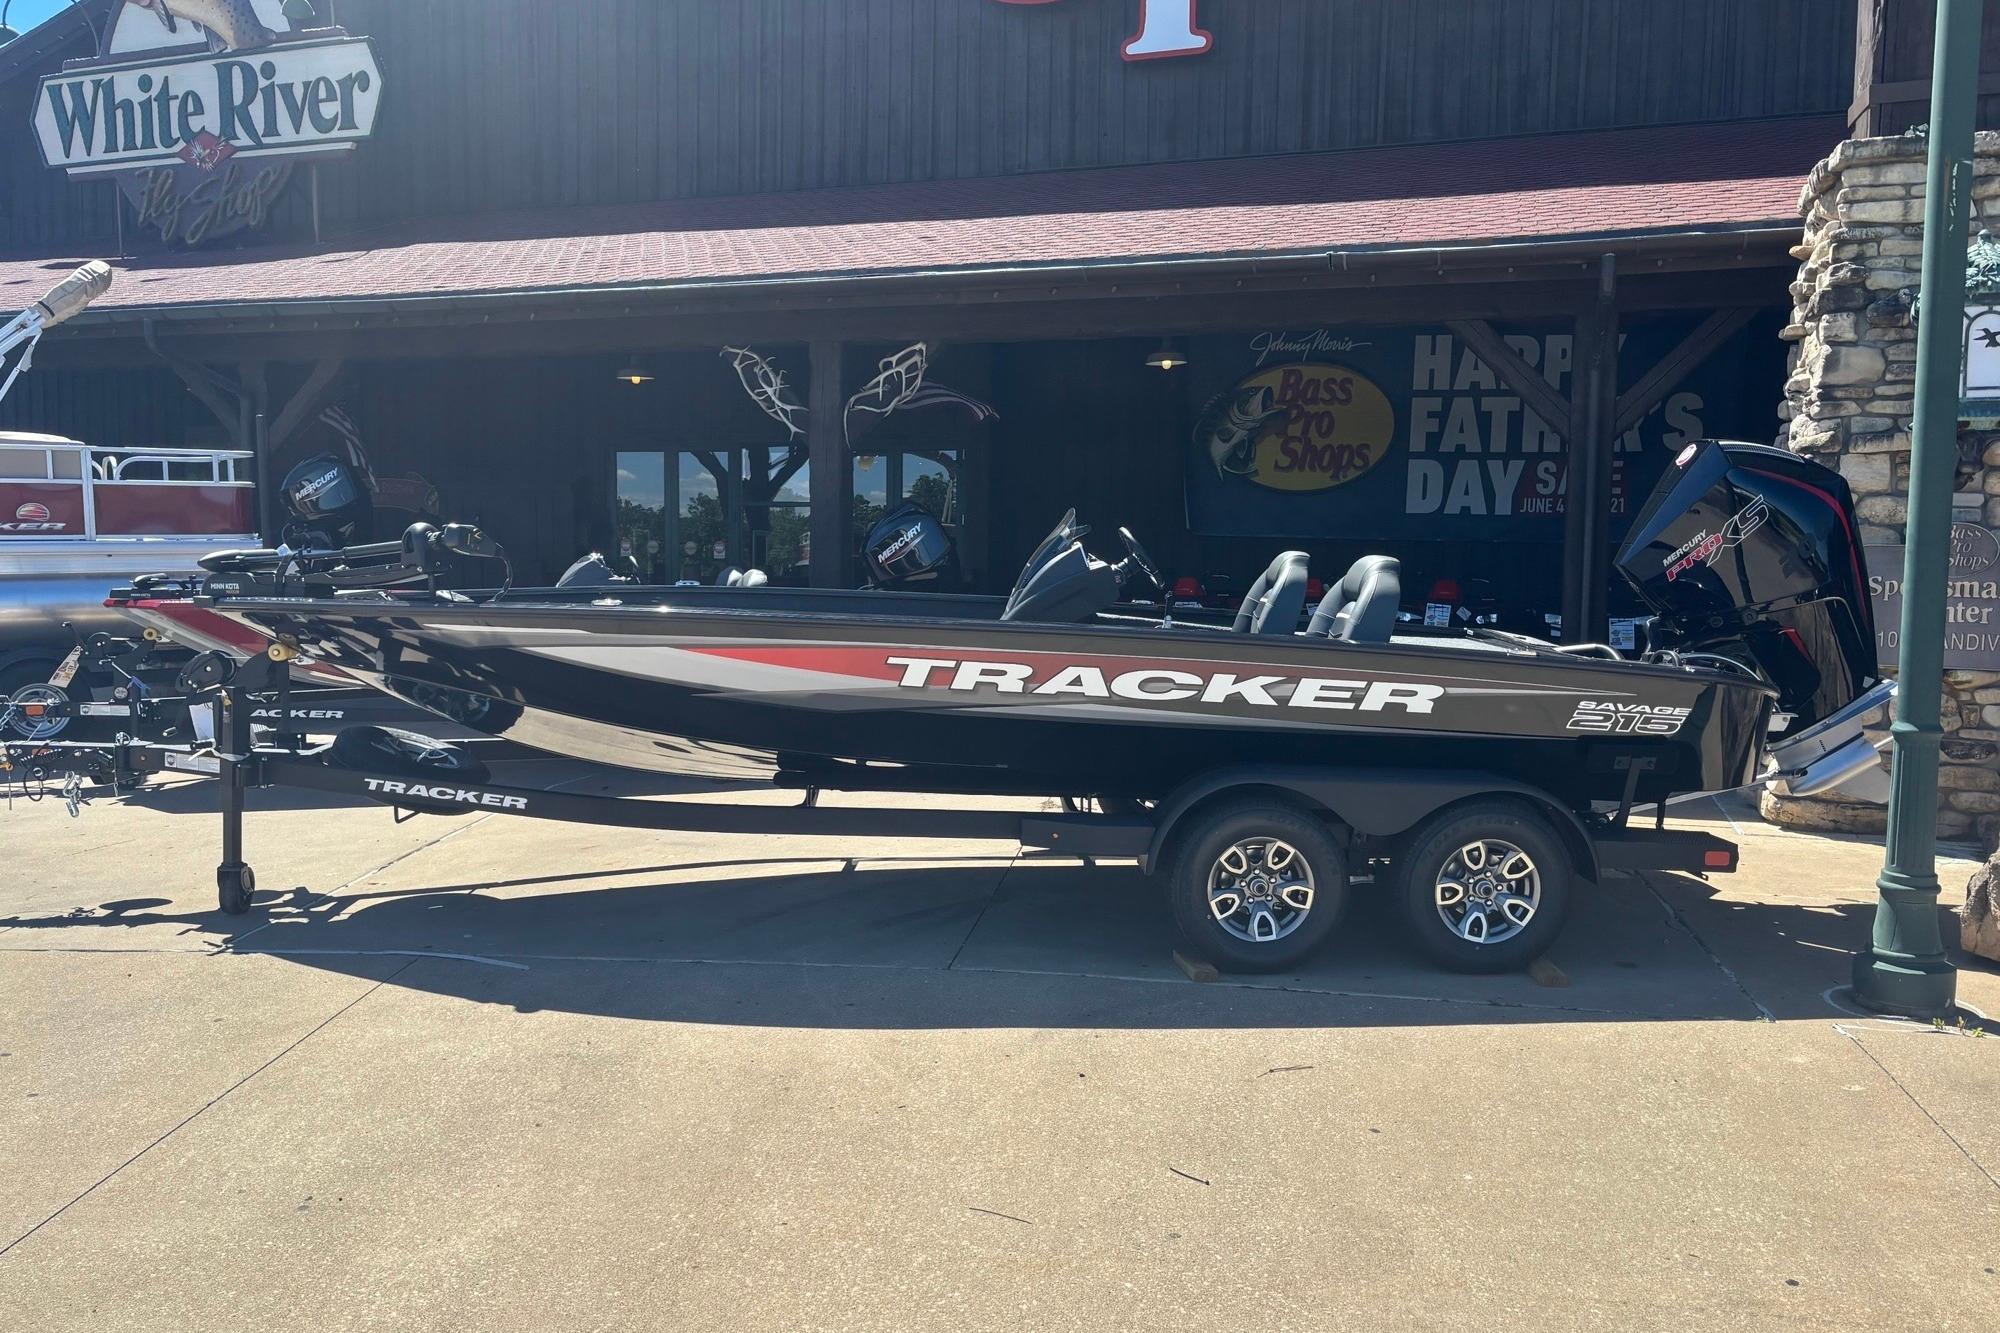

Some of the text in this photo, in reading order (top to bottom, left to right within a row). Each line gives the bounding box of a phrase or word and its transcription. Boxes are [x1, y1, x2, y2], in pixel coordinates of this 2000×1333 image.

[46, 60, 370, 159] White River
[134, 160, 284, 244] Fly Shop
[1275, 368, 1354, 406] Bass
[1288, 402, 1336, 440] Pro
[1273, 436, 1370, 482] Shops
[295, 467, 339, 500] MERCURY
[1405, 459, 1526, 515] DAY
[1520, 497, 1553, 514] JUNE
[1609, 497, 1625, 514] 21
[877, 522, 922, 563] MERCURY
[1662, 529, 1707, 567] MERCURY
[886, 656, 1446, 714] TRACKER
[1565, 710, 1687, 735] 215
[1577, 700, 1693, 715] SAVAGE
[364, 777, 528, 810] TRACKER
